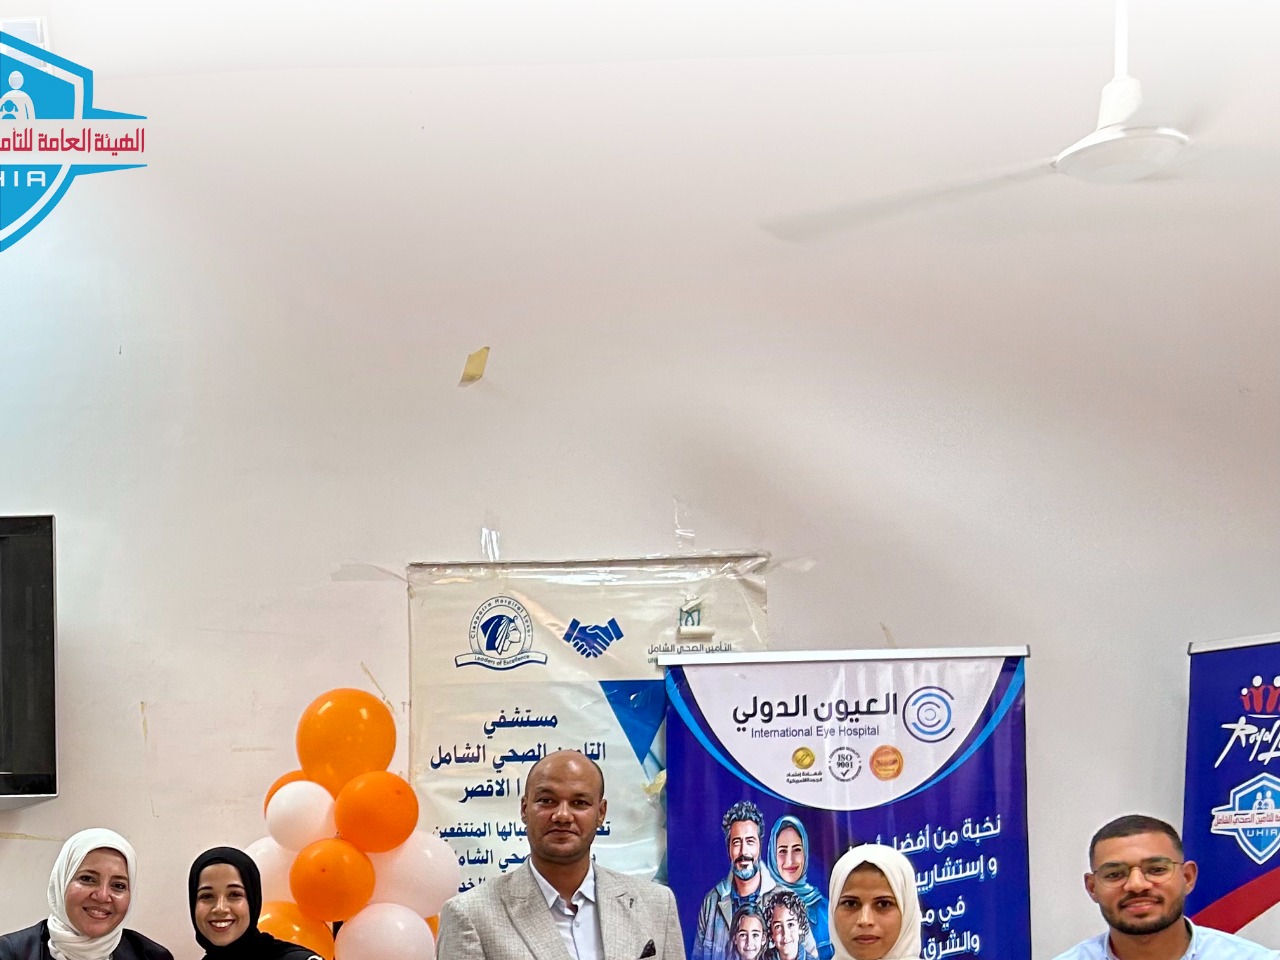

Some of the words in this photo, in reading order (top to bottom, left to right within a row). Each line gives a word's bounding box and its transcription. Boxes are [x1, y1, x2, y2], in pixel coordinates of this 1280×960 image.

[648, 642, 675, 655] الشامل
[732, 694, 807, 732] الدولي
[813, 692, 898, 723] العيون
[751, 726, 813, 739] International
[816, 726, 835, 740] Eye
[839, 725, 880, 739] Hospital
[430, 743, 486, 769] الشامل
[934, 827, 958, 851] من
[963, 814, 1001, 846] نخبة
[1246, 829, 1278, 837] UHIA
[938, 895, 966, 929] في
[923, 929, 980, 960] والشرق
